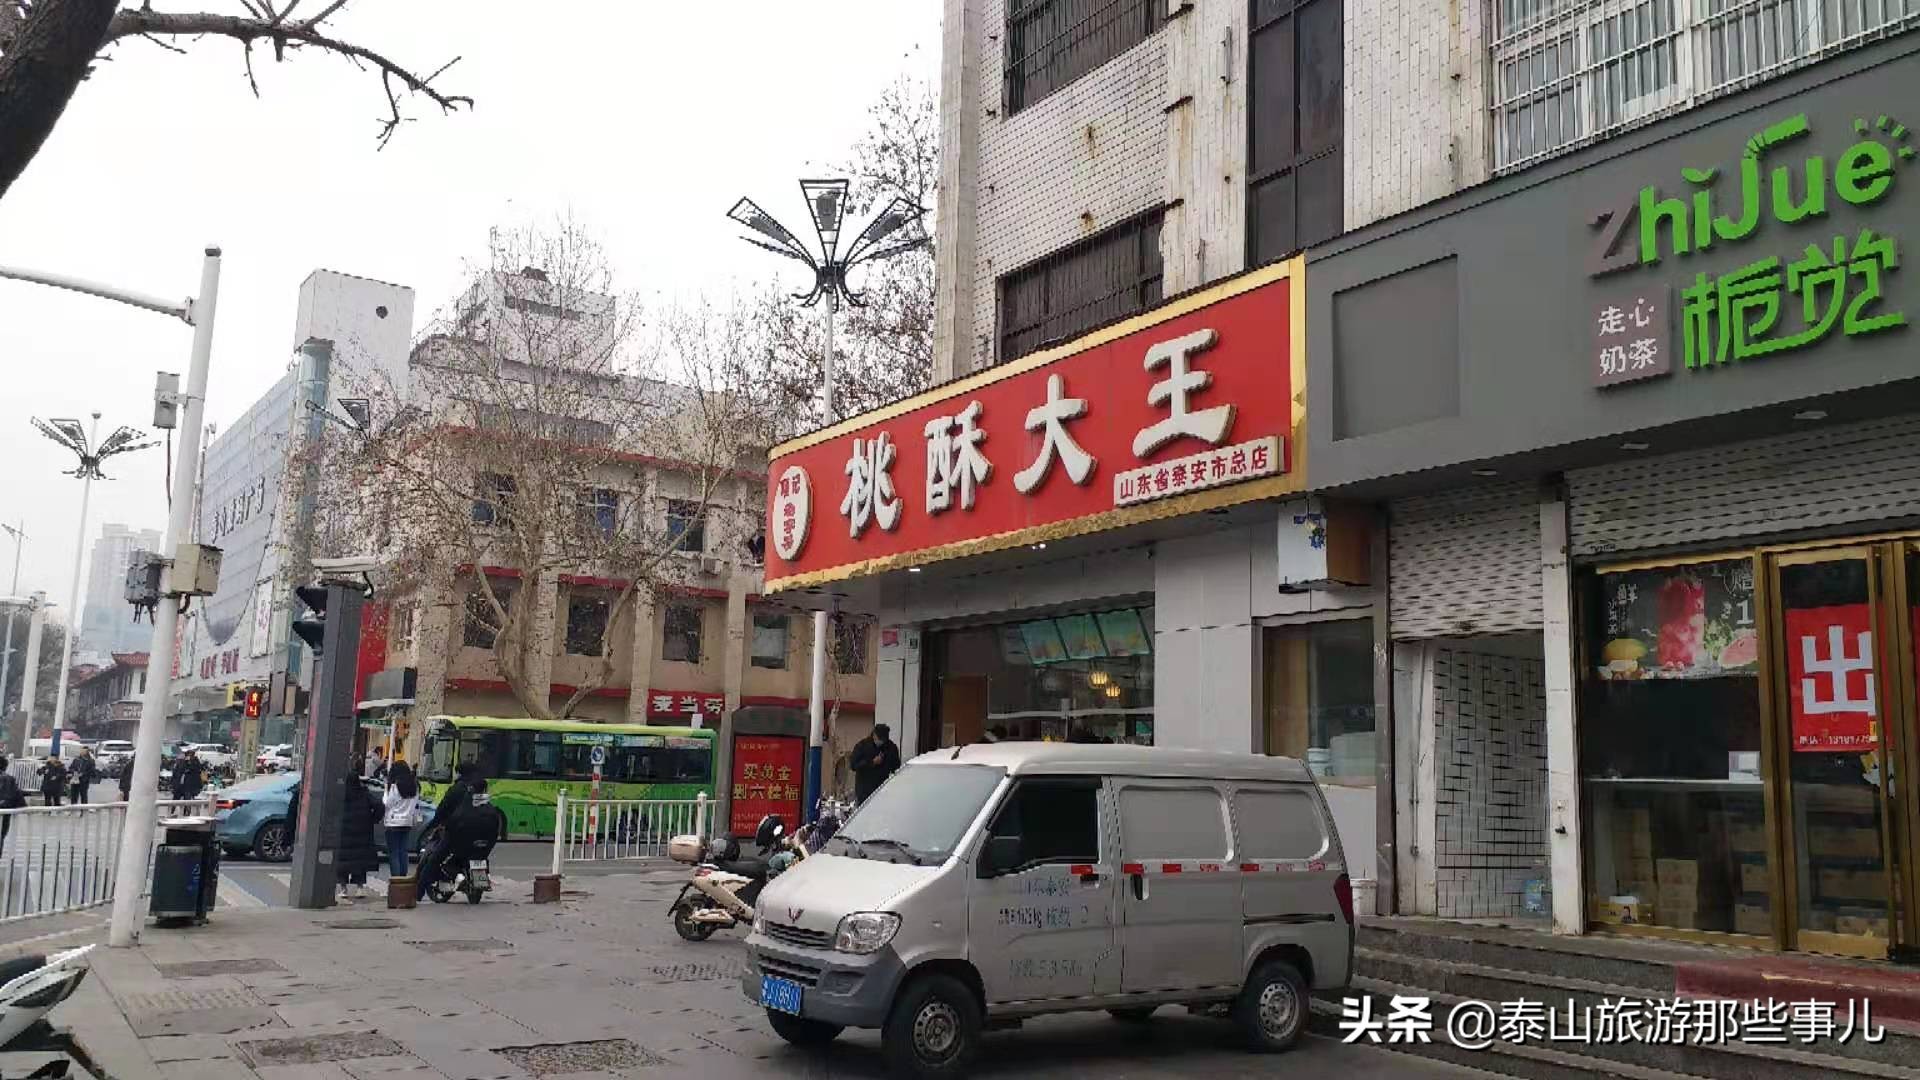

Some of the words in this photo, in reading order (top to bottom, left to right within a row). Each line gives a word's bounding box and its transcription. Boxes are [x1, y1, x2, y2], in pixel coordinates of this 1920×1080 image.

[1597, 298, 1657, 337] 走心
[1599, 338, 1660, 378] 奶茶
[839, 326, 1240, 540] 桃酥大王
[1119, 444, 1270, 501] 山东省泰安市总店
[1801, 625, 1877, 716] 出
[652, 694, 724, 715] 麦当劳
[733, 783, 800, 801] 到六桂福
[743, 763, 793, 782] 买黄金
